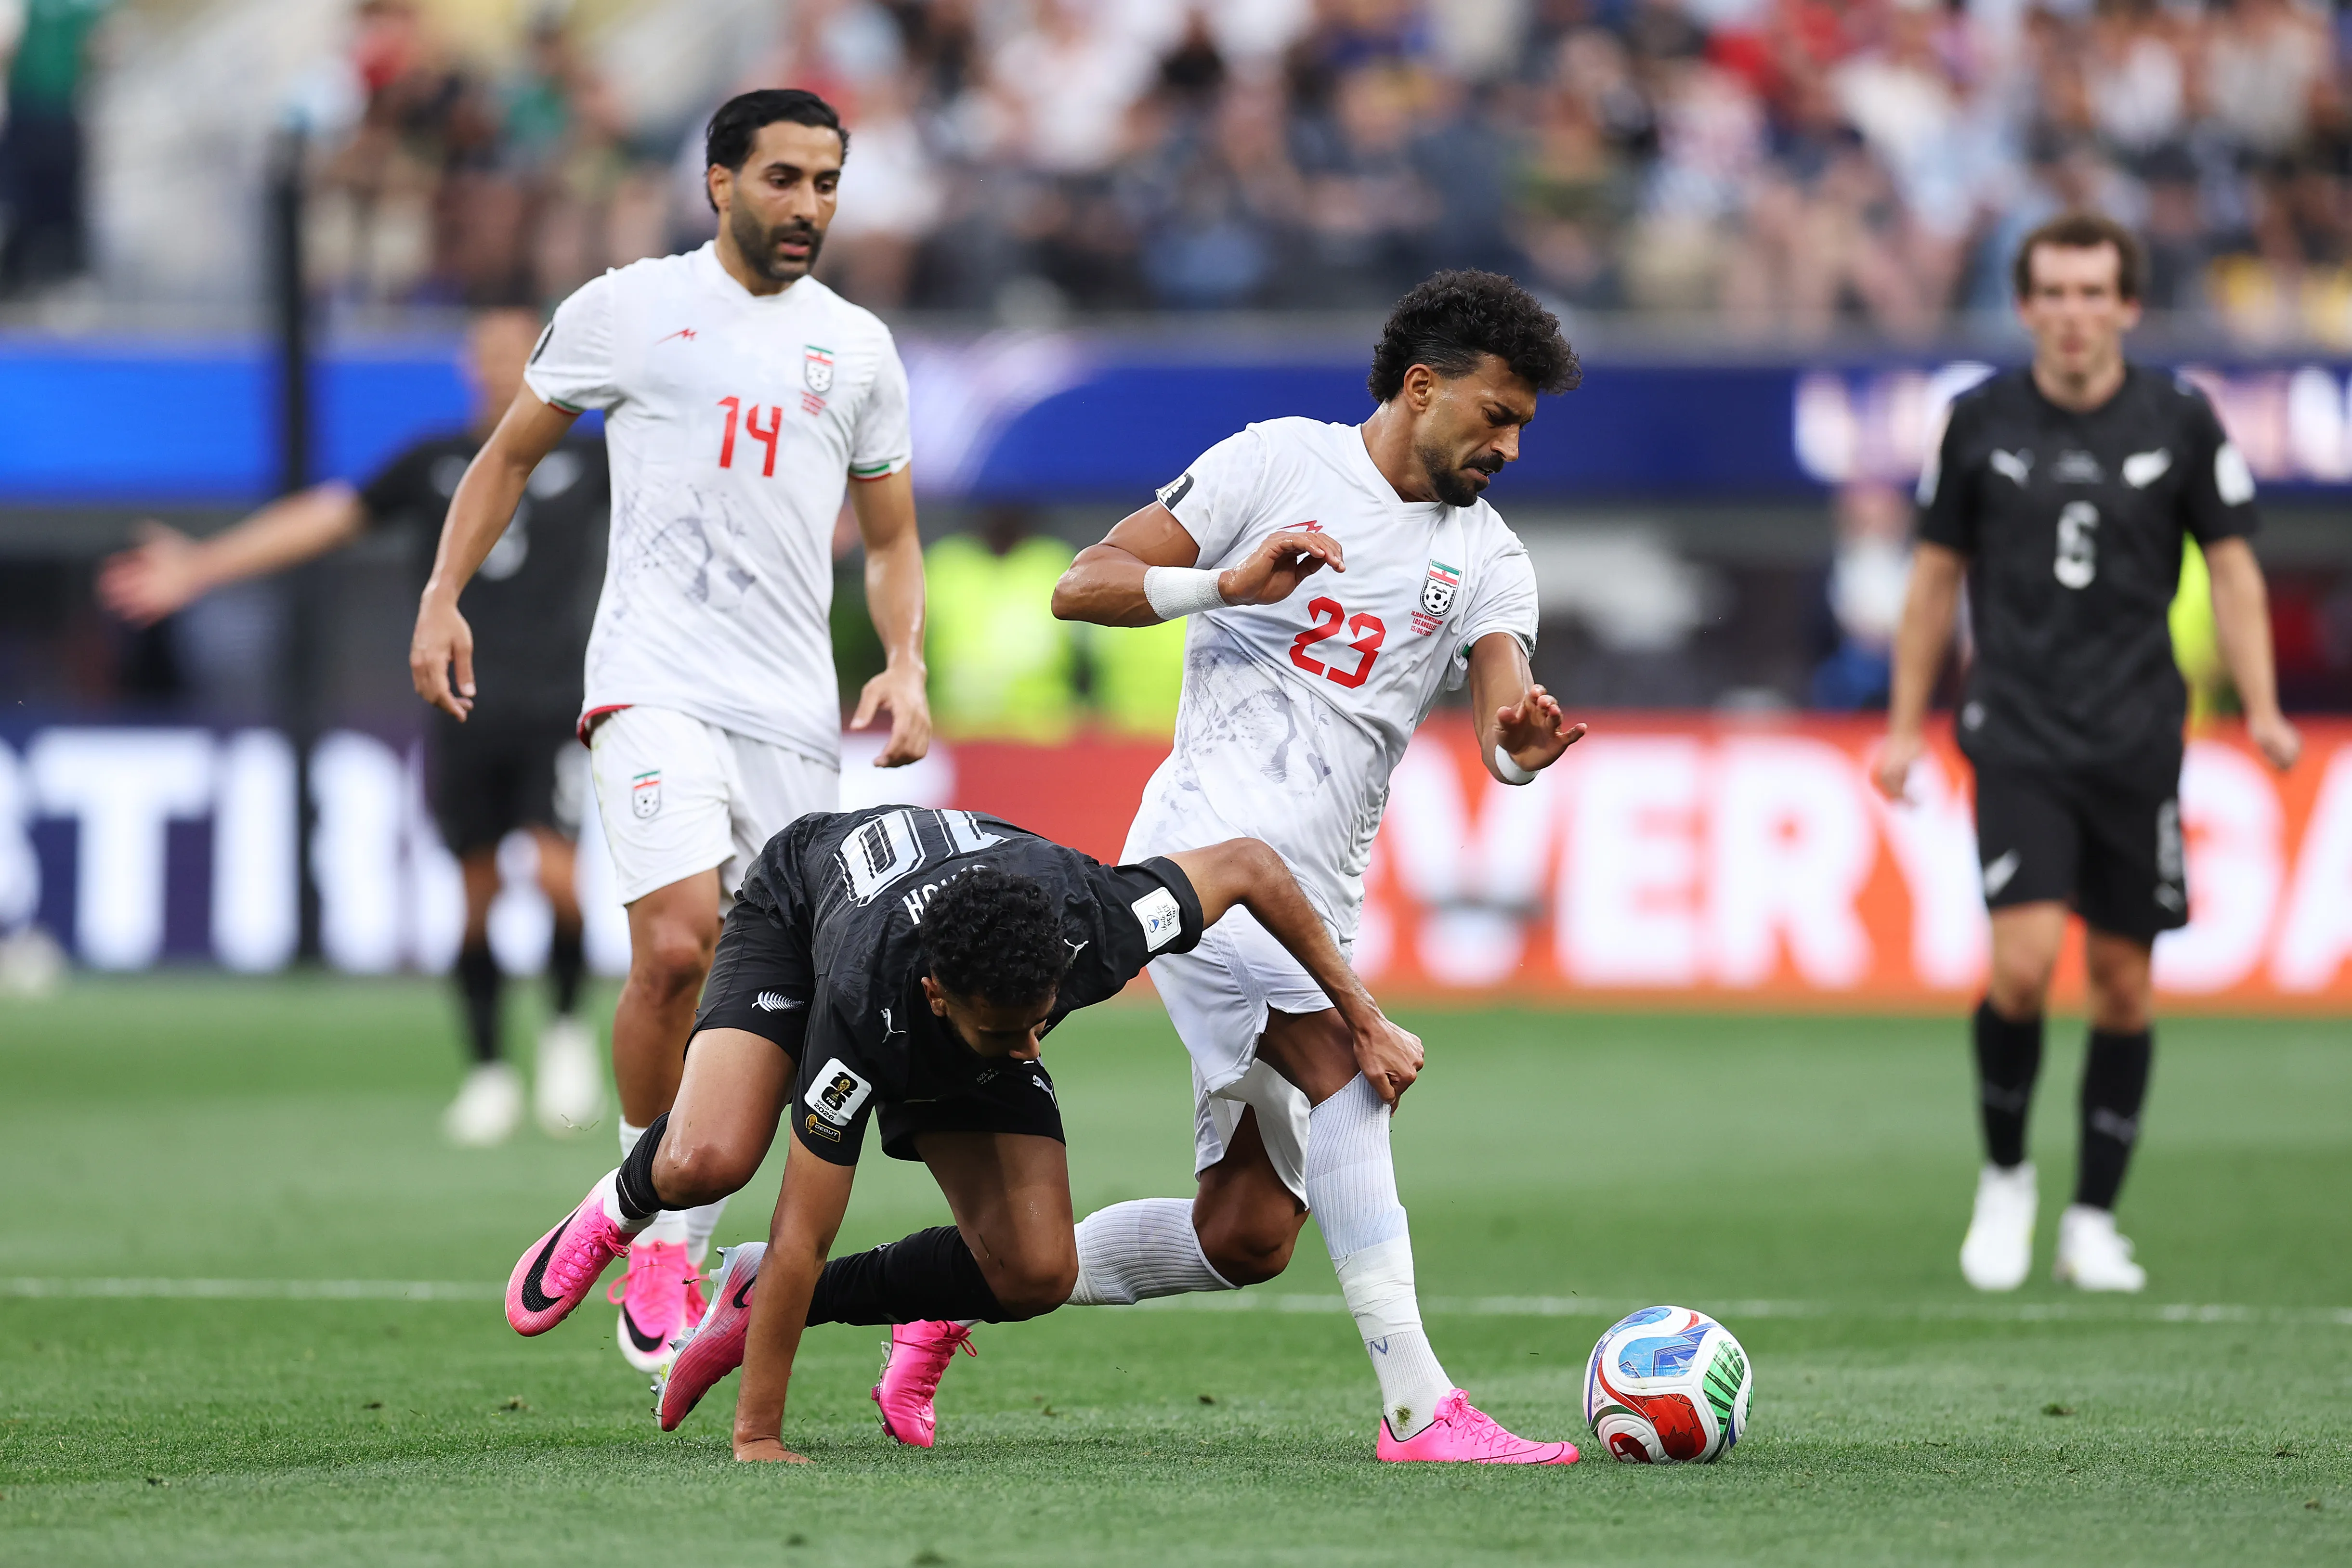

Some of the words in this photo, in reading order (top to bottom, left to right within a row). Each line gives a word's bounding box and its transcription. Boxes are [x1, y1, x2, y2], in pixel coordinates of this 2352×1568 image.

[718, 396, 782, 477] 14
[2053, 500, 2101, 590] 6
[1289, 596, 1387, 689] 23
[1161, 902, 1173, 926] PEACE
[976, 1071, 988, 1083] NZL
[817, 1099, 830, 1111] WORLD
[825, 1096, 836, 1107] FIFA
[814, 1102, 836, 1121] 2026
[814, 1124, 838, 1137] DEBUT
